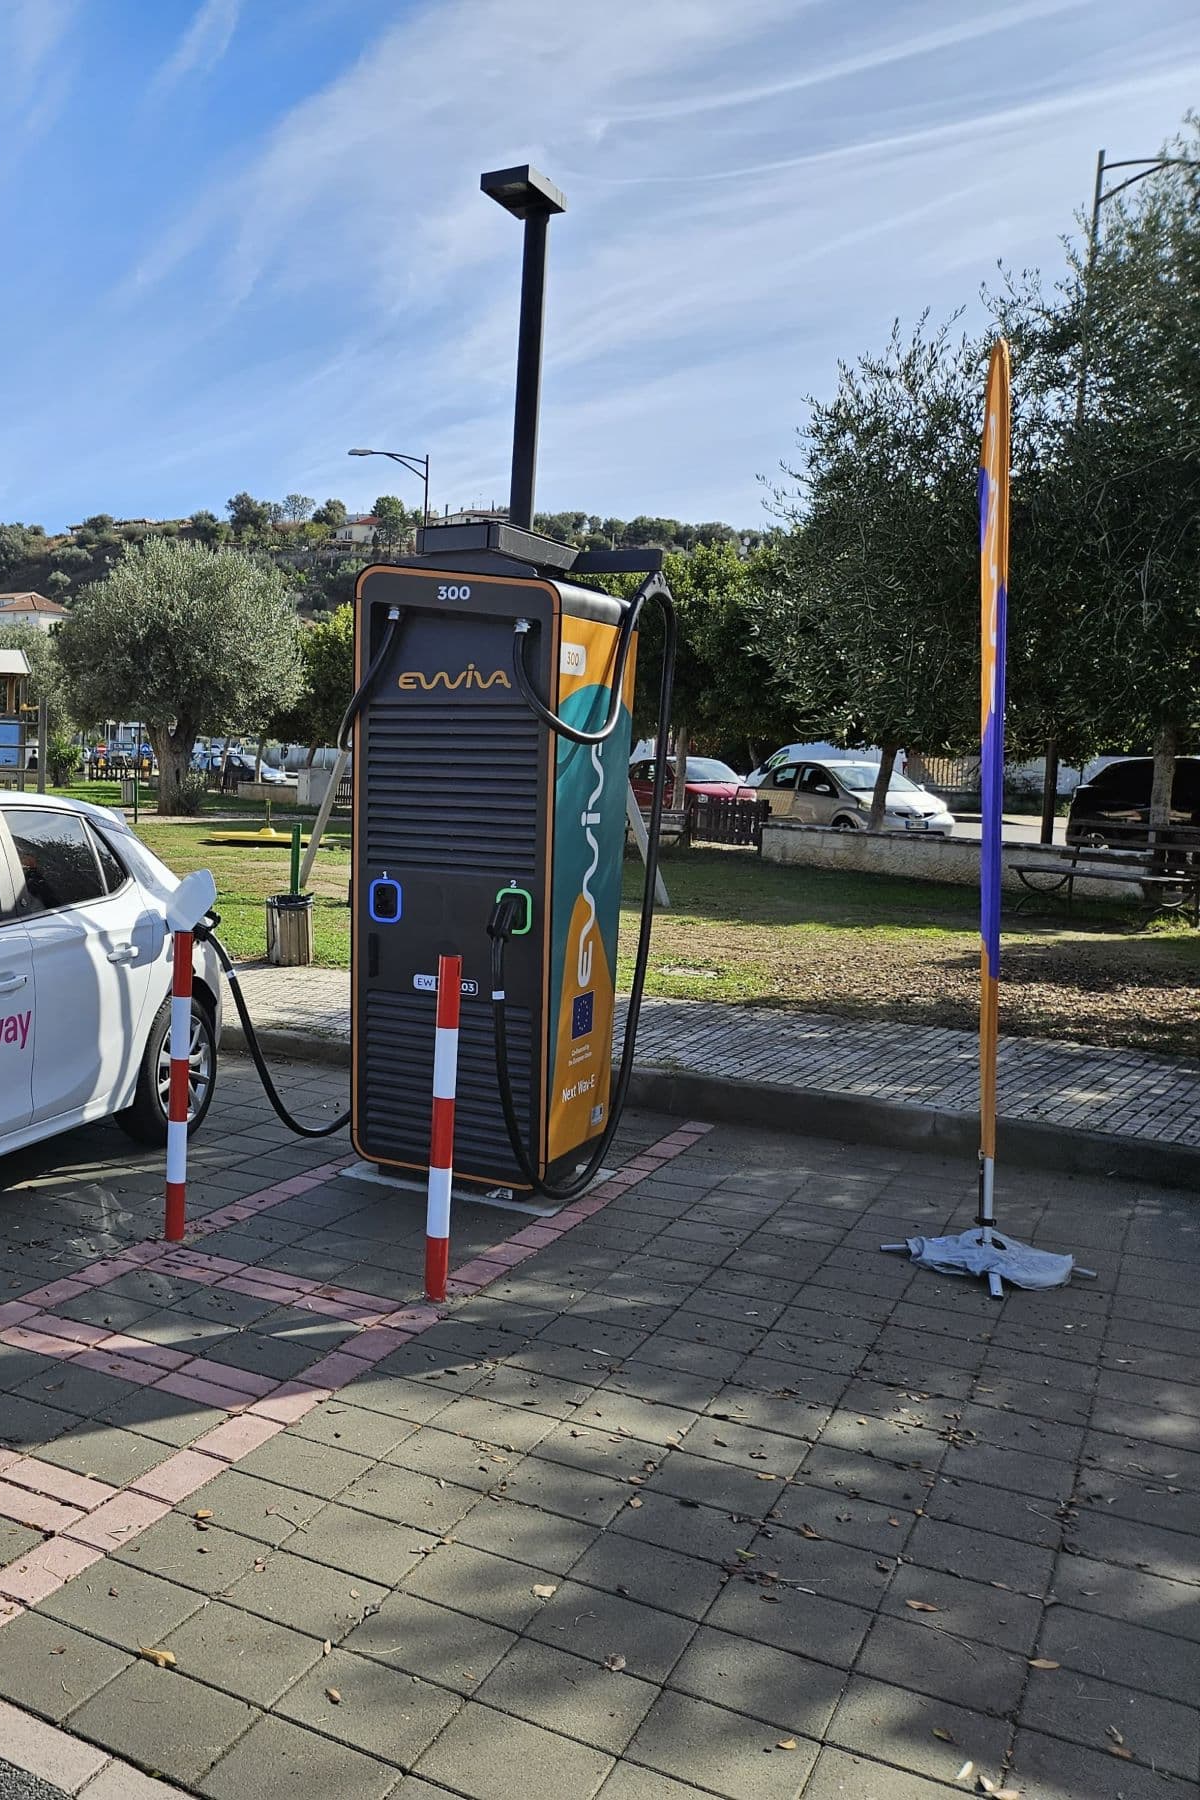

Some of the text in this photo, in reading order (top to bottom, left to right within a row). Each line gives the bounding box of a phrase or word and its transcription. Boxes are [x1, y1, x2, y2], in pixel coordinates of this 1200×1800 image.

[437, 585, 471, 600] 300
[382, 871, 388, 880] 1
[510, 880, 517, 888] 2
[417, 977, 433, 987] EW
[561, 1085, 577, 1103] Next
